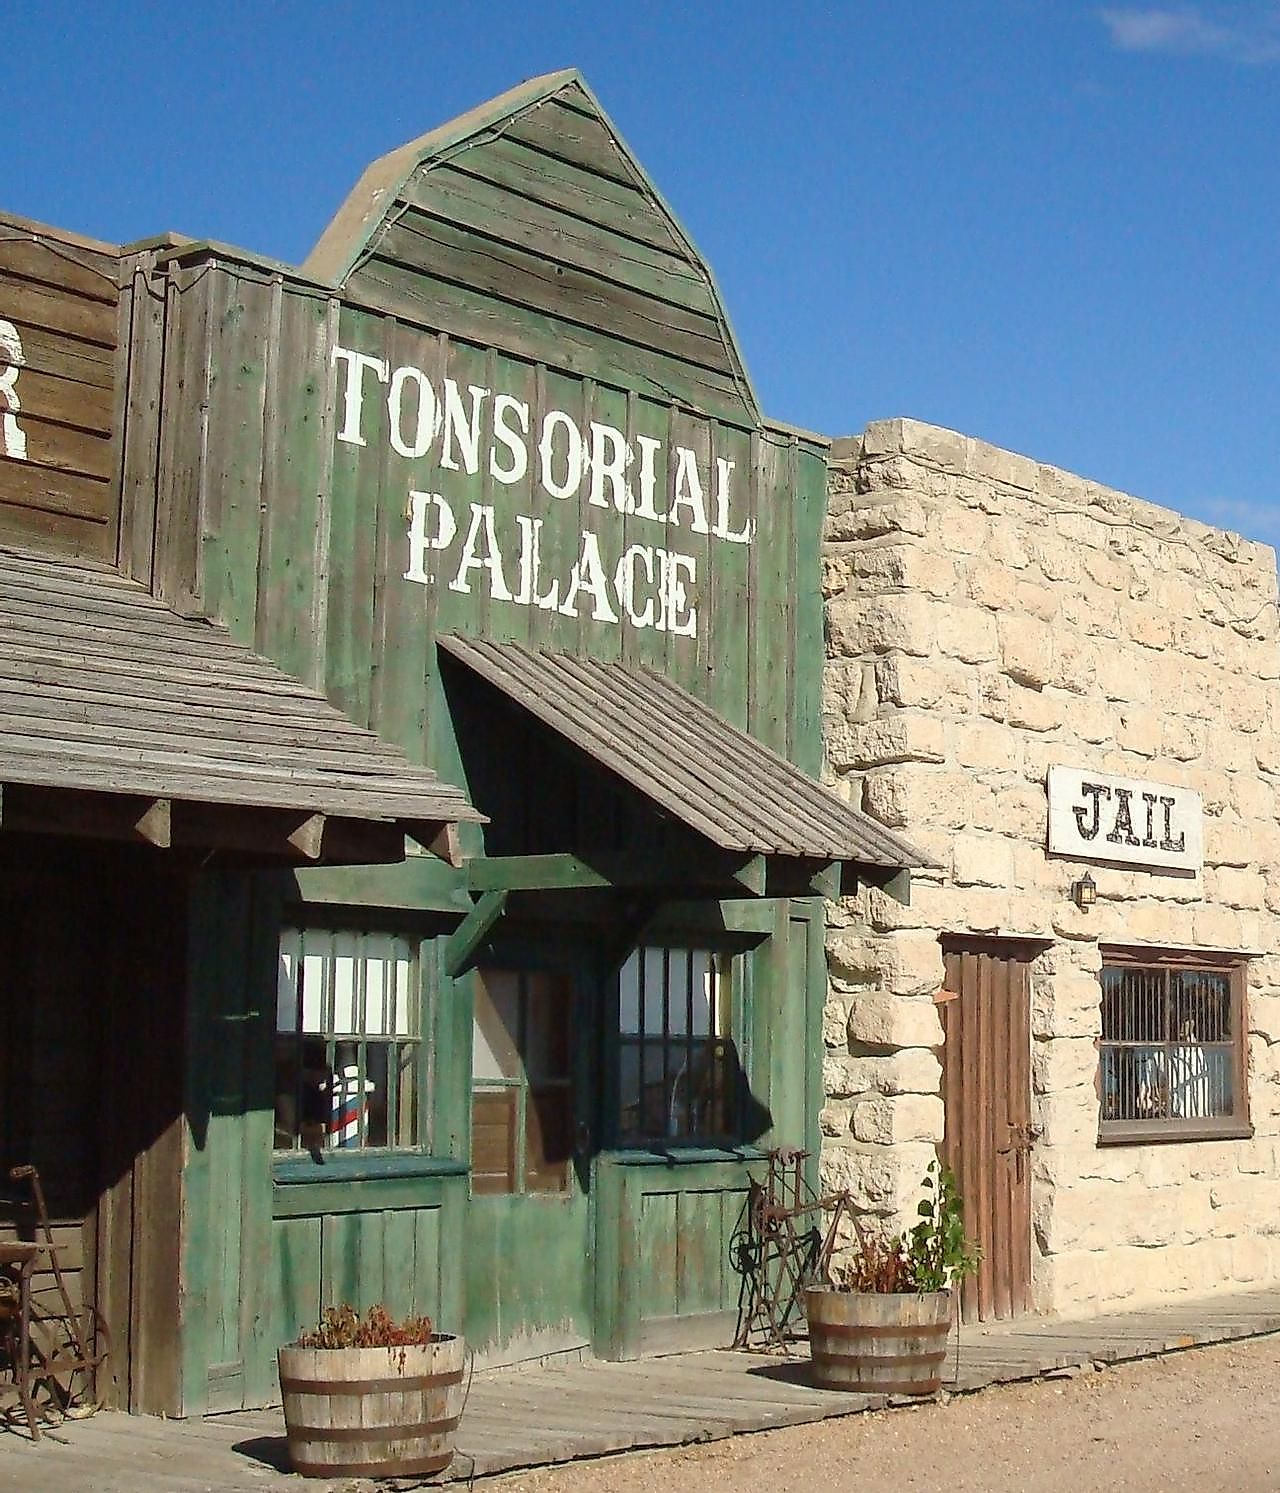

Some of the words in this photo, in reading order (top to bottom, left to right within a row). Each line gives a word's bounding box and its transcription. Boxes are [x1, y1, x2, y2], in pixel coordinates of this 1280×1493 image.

[332, 345, 756, 545] TONSORIAL
[403, 489, 697, 638] PALACE
[1073, 782, 1185, 852] JAIL
